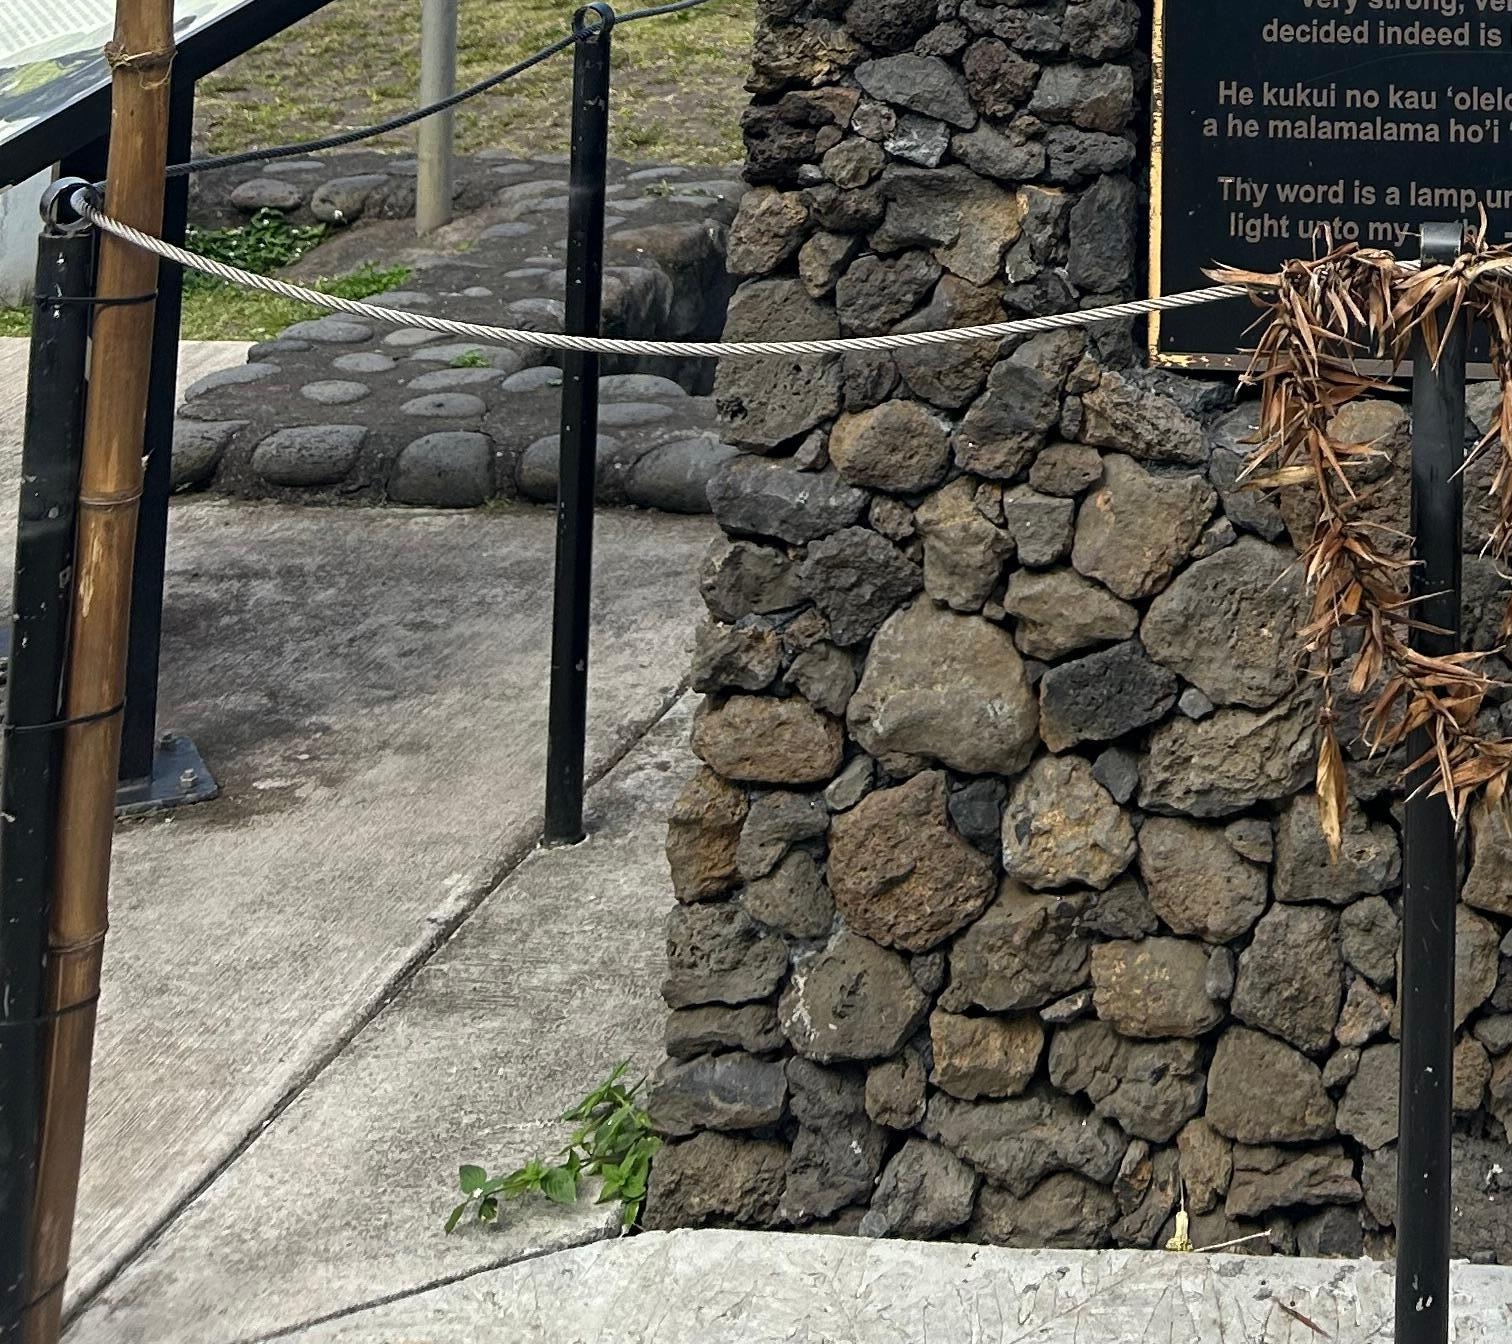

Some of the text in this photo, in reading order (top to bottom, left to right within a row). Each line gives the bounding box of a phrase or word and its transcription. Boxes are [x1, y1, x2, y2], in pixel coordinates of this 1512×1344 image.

[1262, 18, 1369, 44] decided
[1378, 20, 1470, 46] indeed
[1479, 22, 1502, 47] is
[1219, 80, 1254, 106] He
[1263, 81, 1336, 108] kukui
[1346, 89, 1380, 109] no
[1389, 84, 1437, 110] kau
[1202, 118, 1218, 137] a
[1227, 112, 1260, 138] he
[1268, 114, 1440, 142] malamalama
[1217, 176, 1269, 208] Thy
[1276, 179, 1345, 204] word
[1353, 179, 1376, 205] is
[1385, 186, 1400, 206] a
[1410, 181, 1477, 214] lamp
[1229, 212, 1291, 244] light
[1297, 217, 1360, 241] unto
[1368, 219, 1410, 247] my
